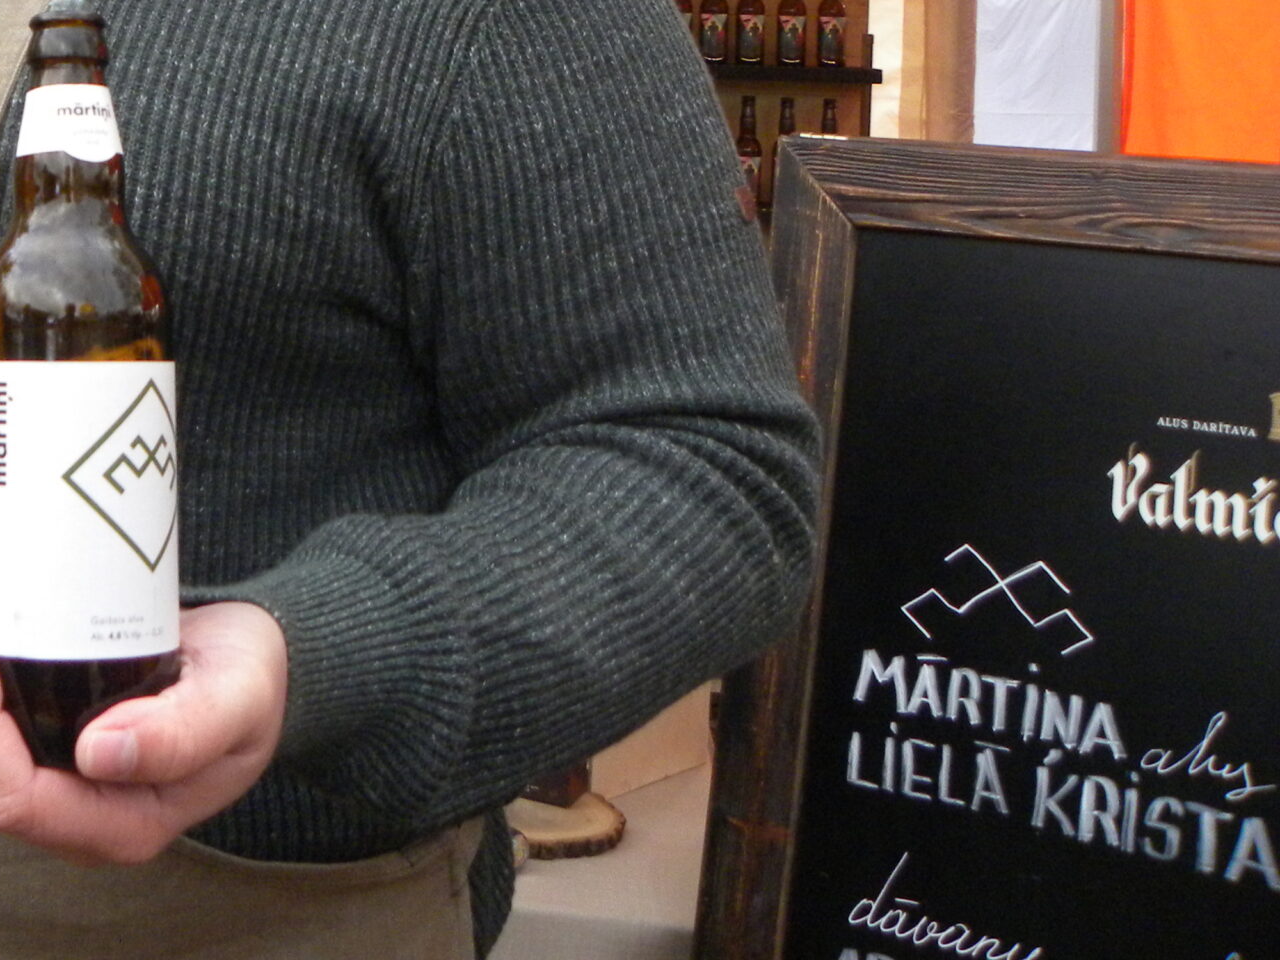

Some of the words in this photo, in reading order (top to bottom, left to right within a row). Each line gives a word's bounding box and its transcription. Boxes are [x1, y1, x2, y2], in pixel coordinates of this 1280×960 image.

[1156, 416, 1189, 430] ALUS
[1107, 441, 1280, 545] Valmi
[1140, 711, 1276, 800] alus
